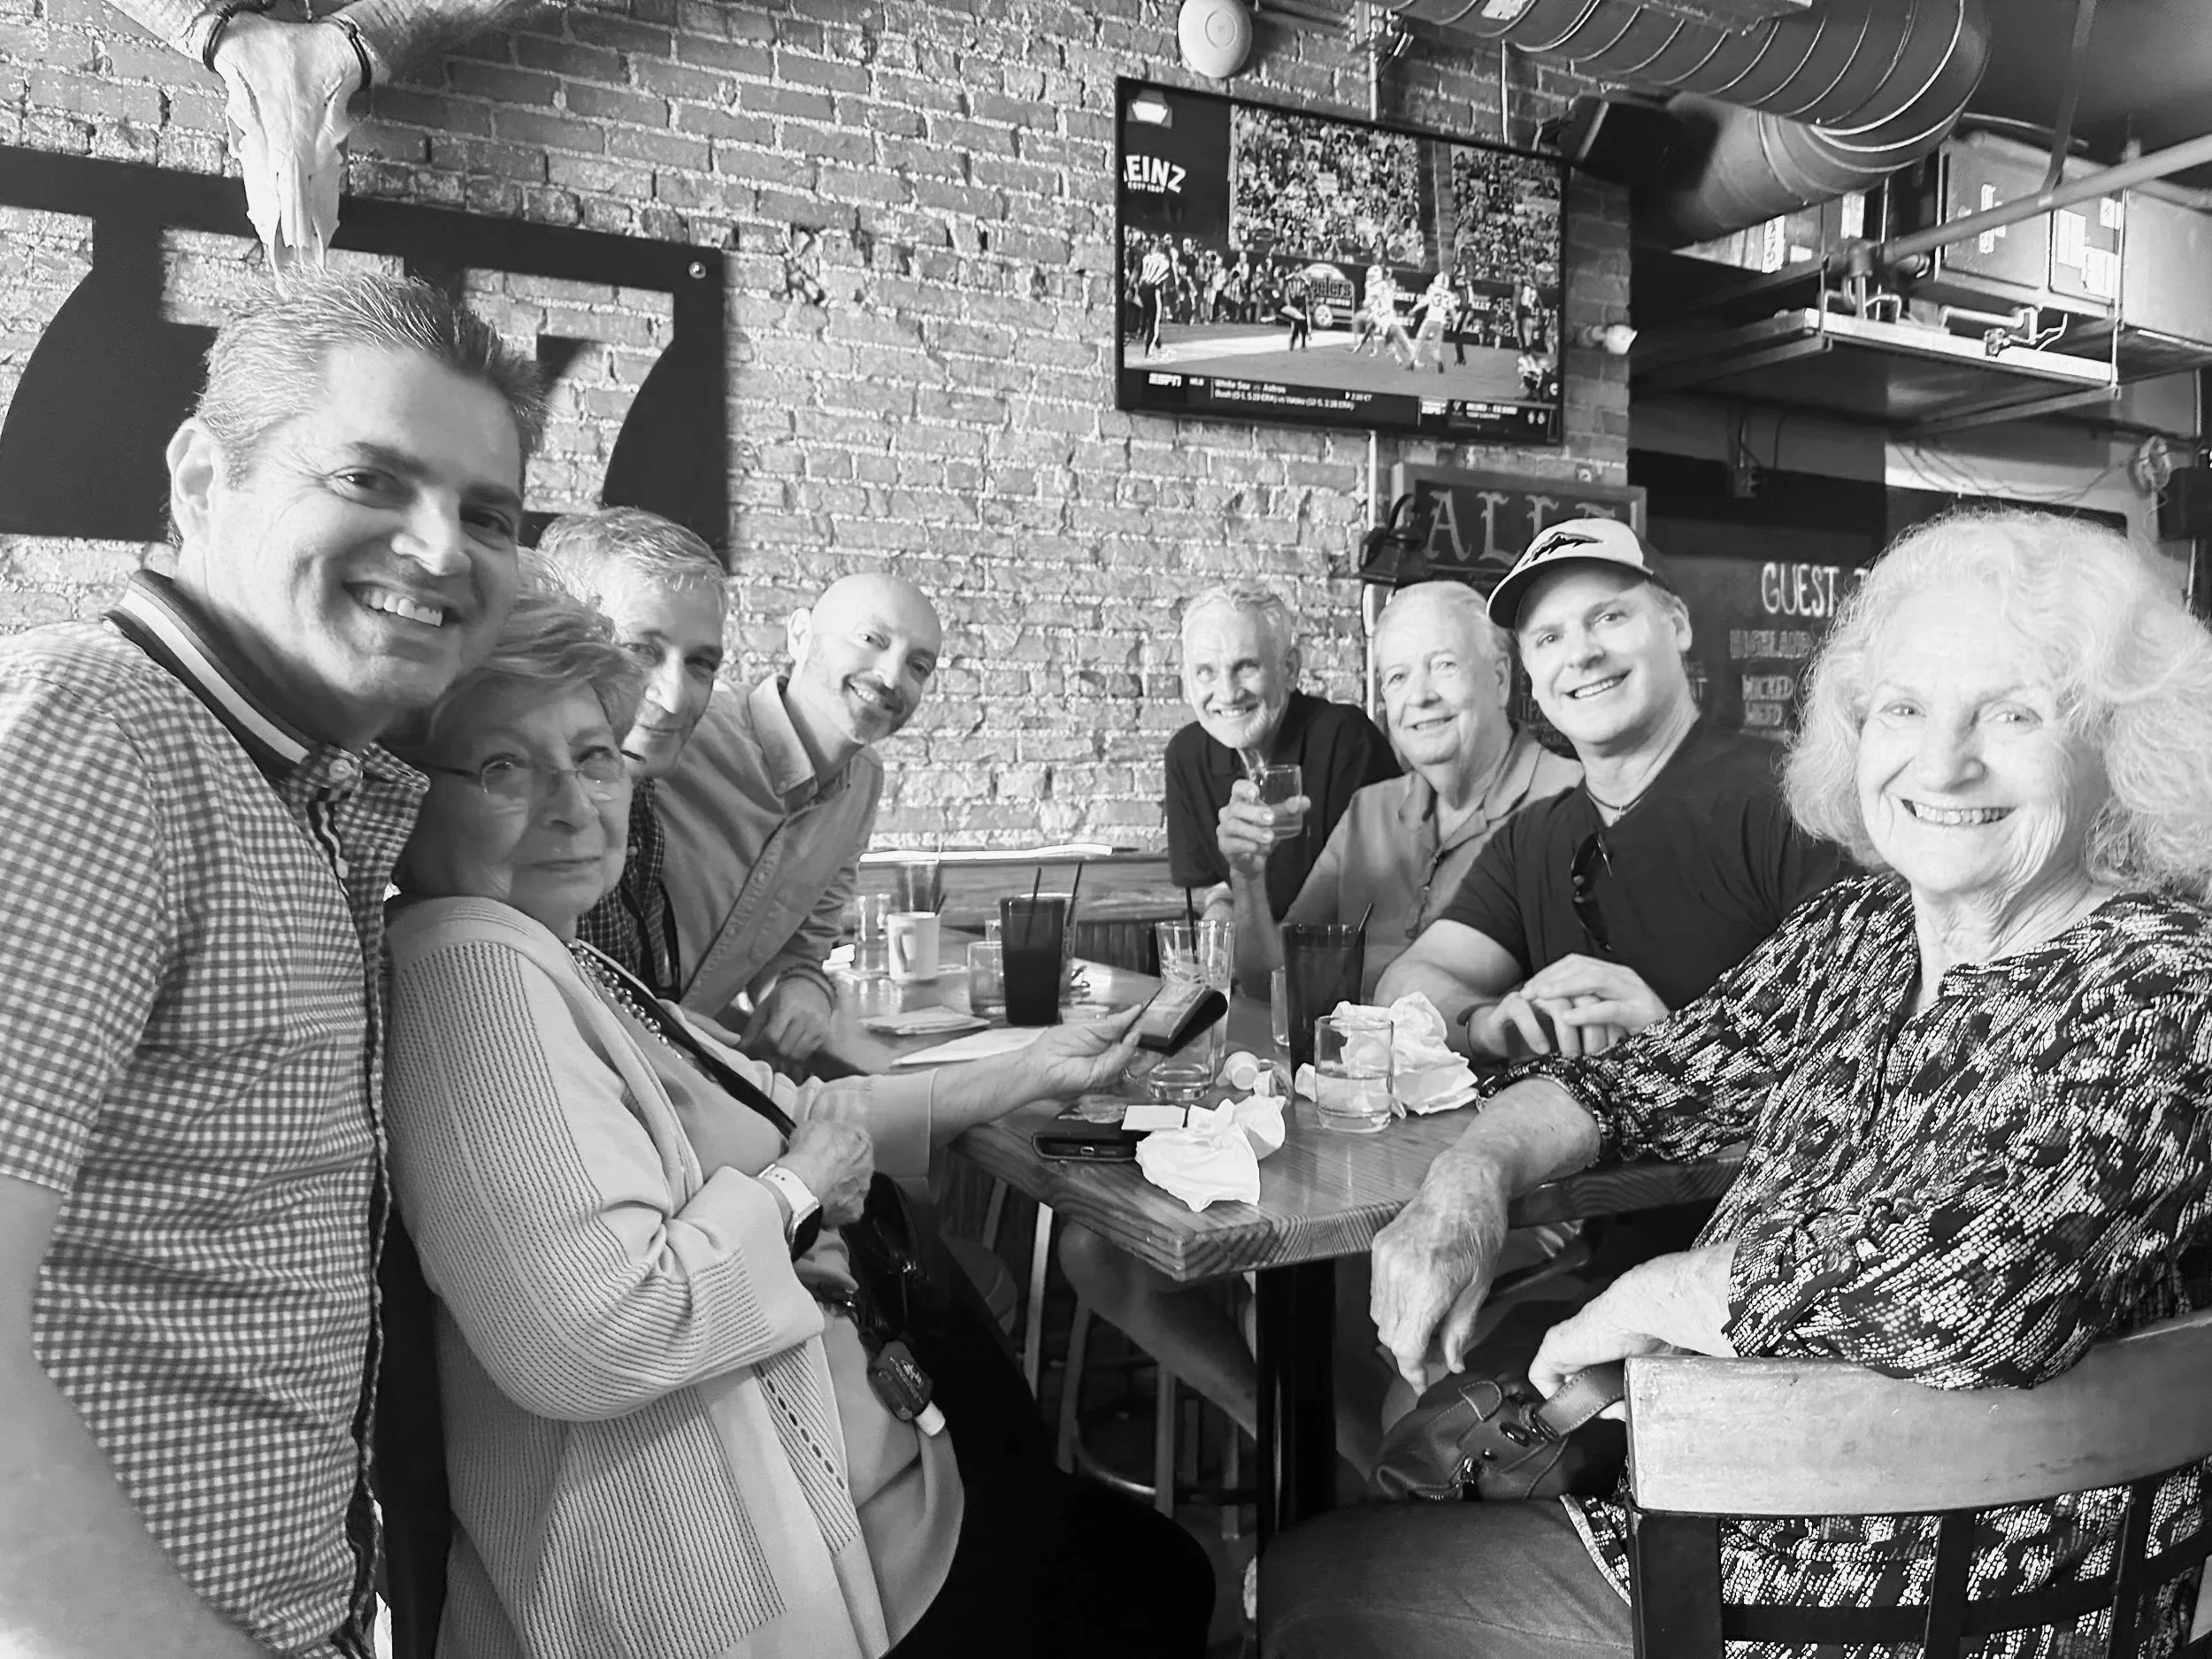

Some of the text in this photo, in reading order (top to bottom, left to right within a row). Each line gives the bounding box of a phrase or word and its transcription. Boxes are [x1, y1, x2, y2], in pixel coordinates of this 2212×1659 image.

[1123, 154, 1187, 194] EINZ
[1148, 372, 1183, 388] ESPN
[1761, 561, 1840, 618] GUEST
